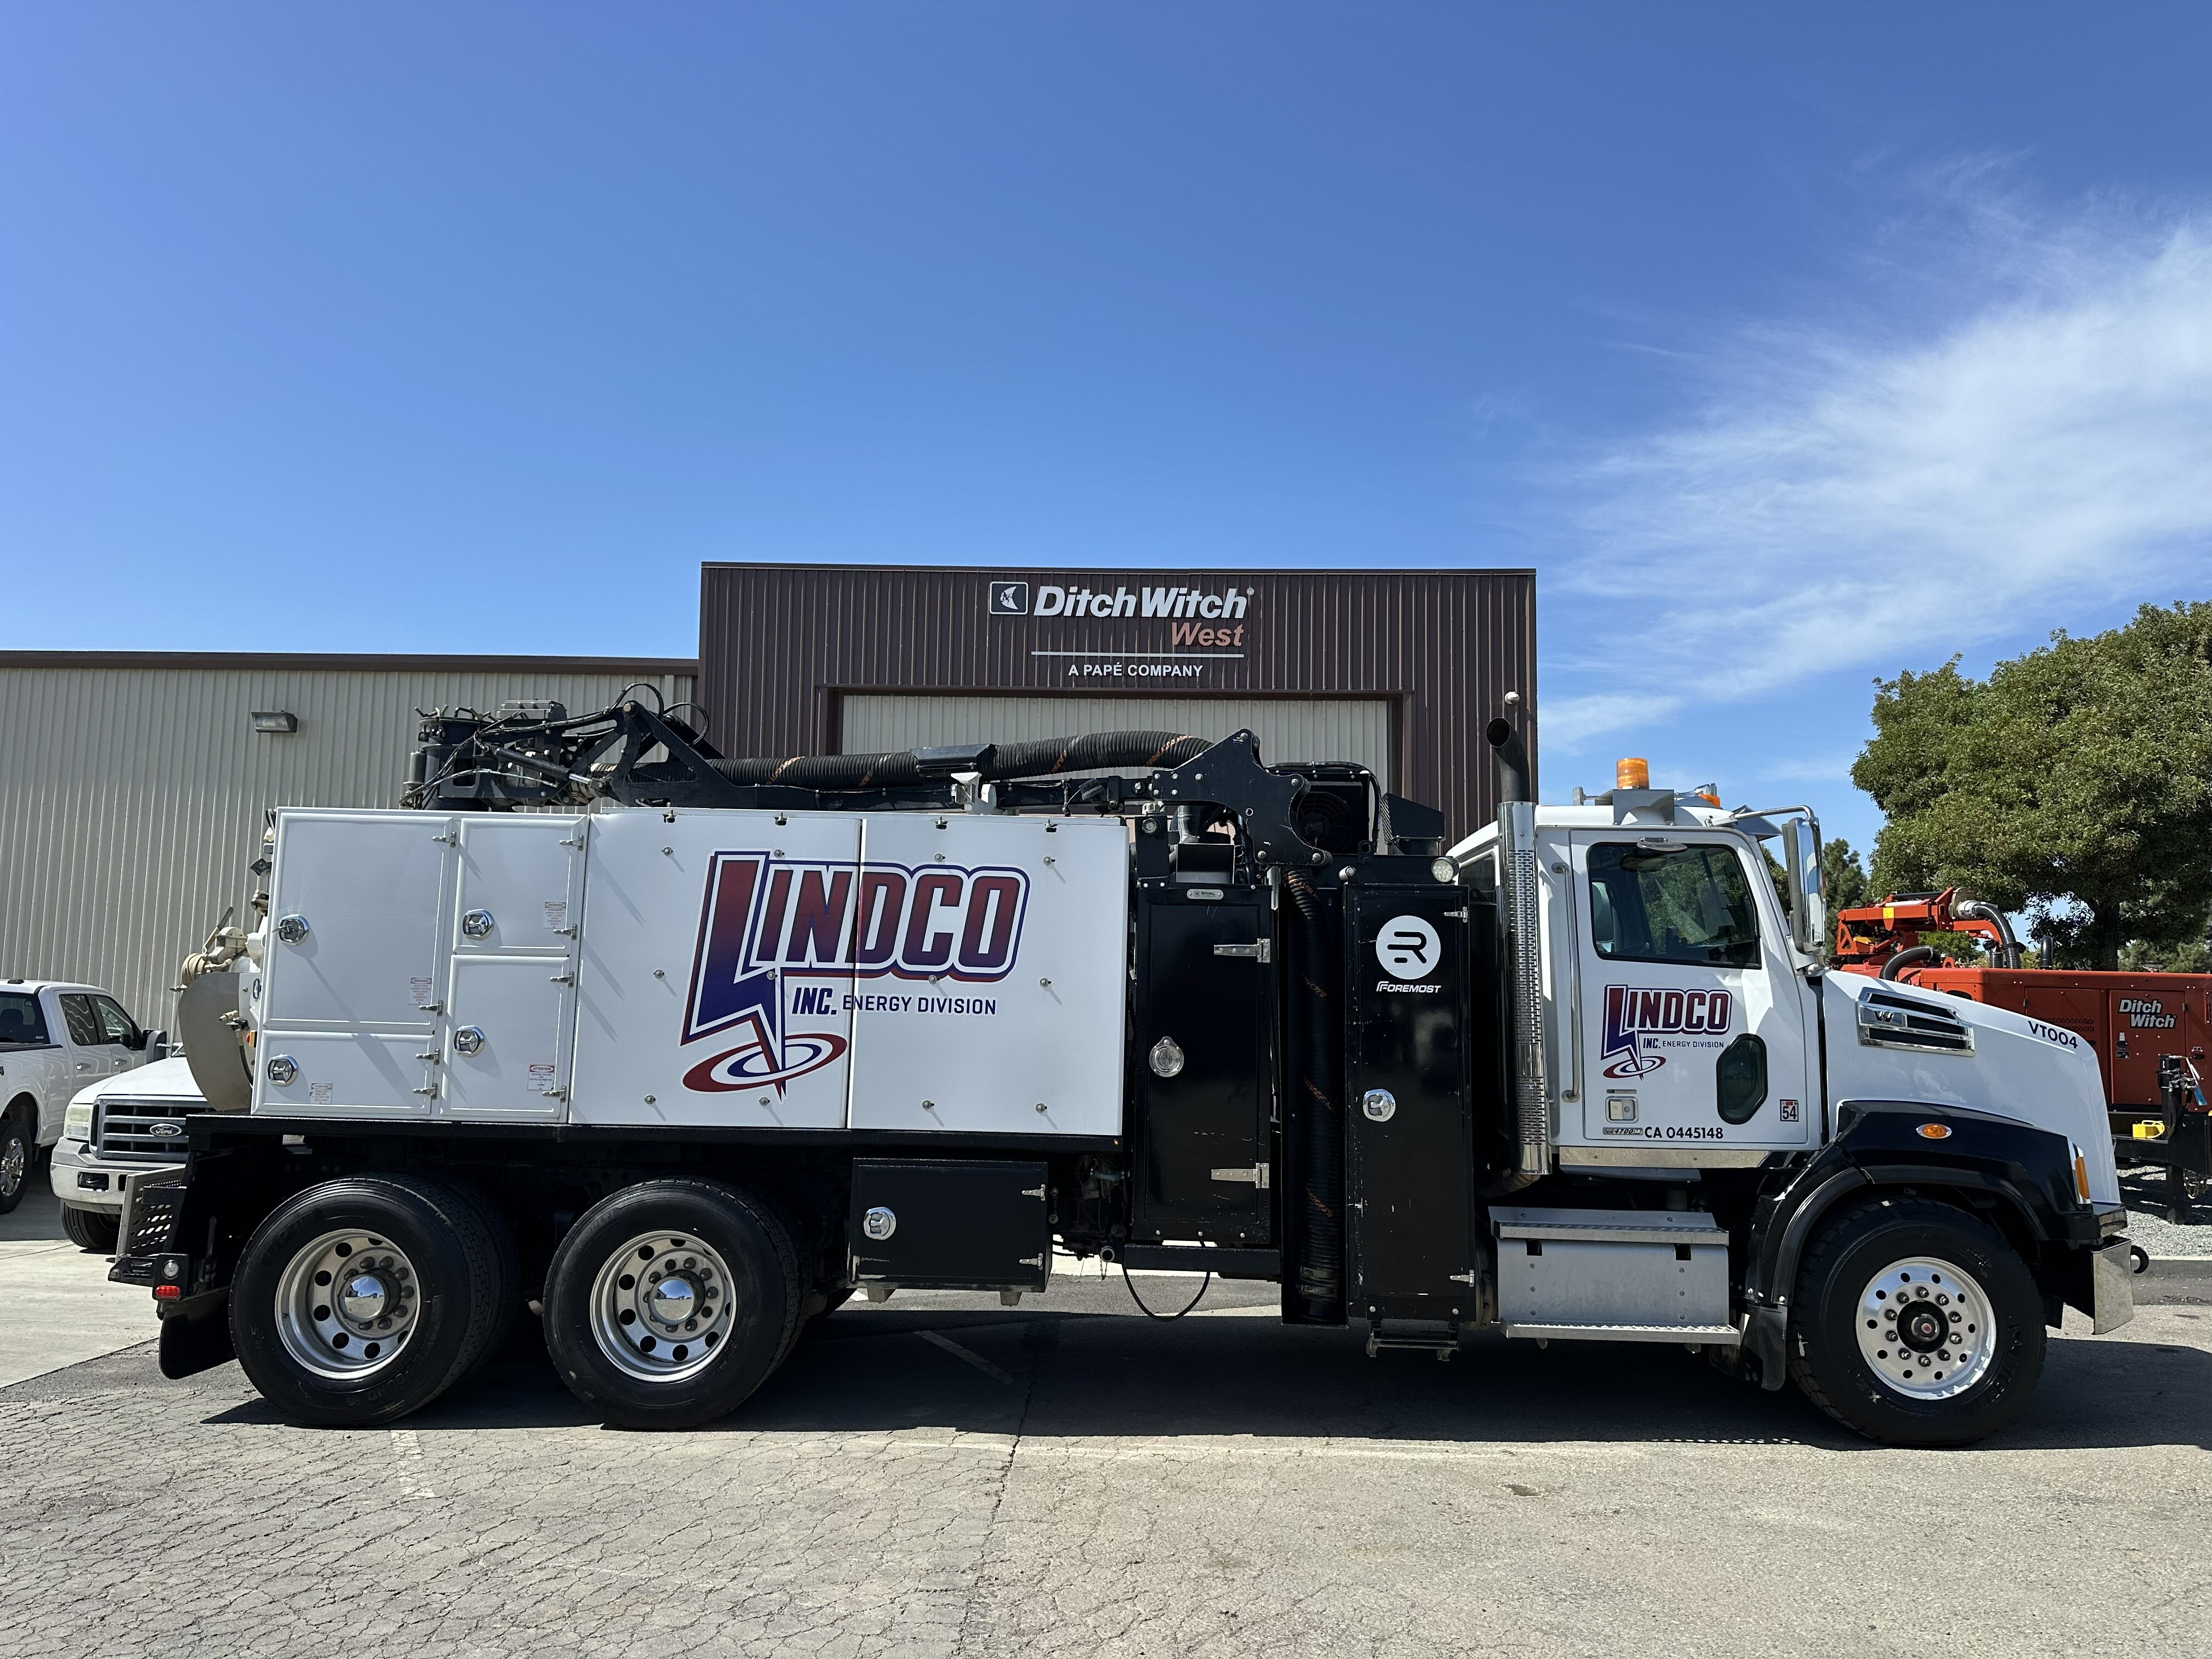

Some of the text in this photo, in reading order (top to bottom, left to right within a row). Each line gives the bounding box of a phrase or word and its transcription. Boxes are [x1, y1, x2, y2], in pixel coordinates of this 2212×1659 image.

[1172, 622, 1244, 646] West
[1068, 662, 1203, 676] A PAPÉ COMPANY
[681, 851, 1030, 1045] LINDCO
[1376, 981, 1441, 993] FOREMOST
[792, 987, 996, 1015] INC. ENERGY DIVISION
[2119, 1000, 2162, 1013] Ditch
[1601, 985, 1732, 1060] LINDCO
[2131, 1014, 2175, 1028] Witch
[1643, 1038, 1661, 1048] INC.
[1782, 1105, 1797, 1120] 54
[156, 1126, 173, 1135] Ford
[1645, 1127, 1723, 1139] CA 0445148
